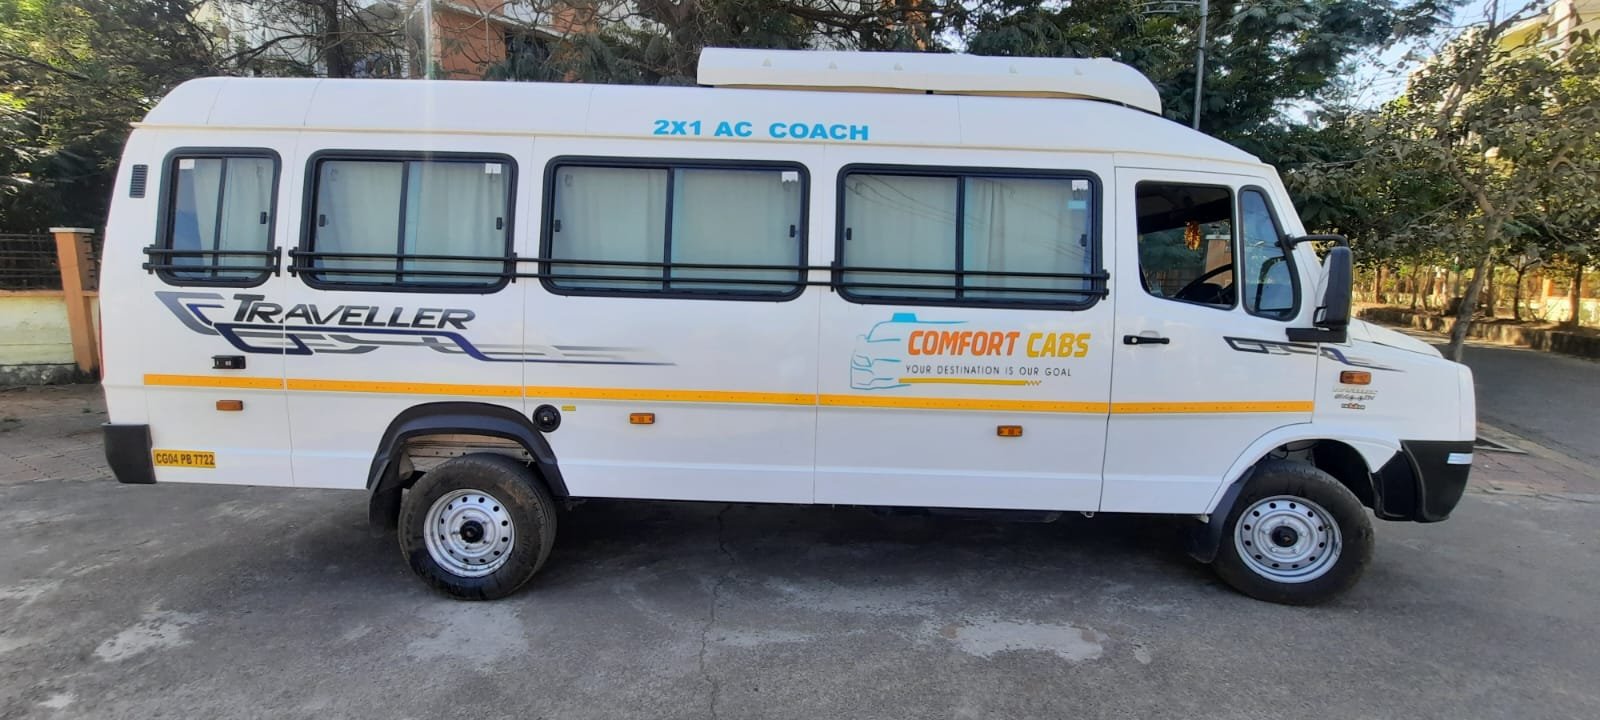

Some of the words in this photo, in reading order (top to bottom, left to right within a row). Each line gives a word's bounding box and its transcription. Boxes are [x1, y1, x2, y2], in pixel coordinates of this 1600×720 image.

[653, 119, 702, 135] 2X1
[714, 121, 752, 137] AC
[768, 122, 869, 141] COACH
[232, 293, 476, 330] TRAVELLER
[908, 330, 1020, 356] COMFORT
[1026, 332, 1091, 358] CABS
[906, 364, 932, 374] YOUR
[937, 365, 1000, 375] DESTINATION
[1005, 366, 1014, 376] IS
[1019, 366, 1039, 377] OUR
[1045, 367, 1072, 377] GOAL
[156, 453, 178, 464] CG04
[180, 454, 192, 465] PB
[193, 454, 215, 466] 7722
